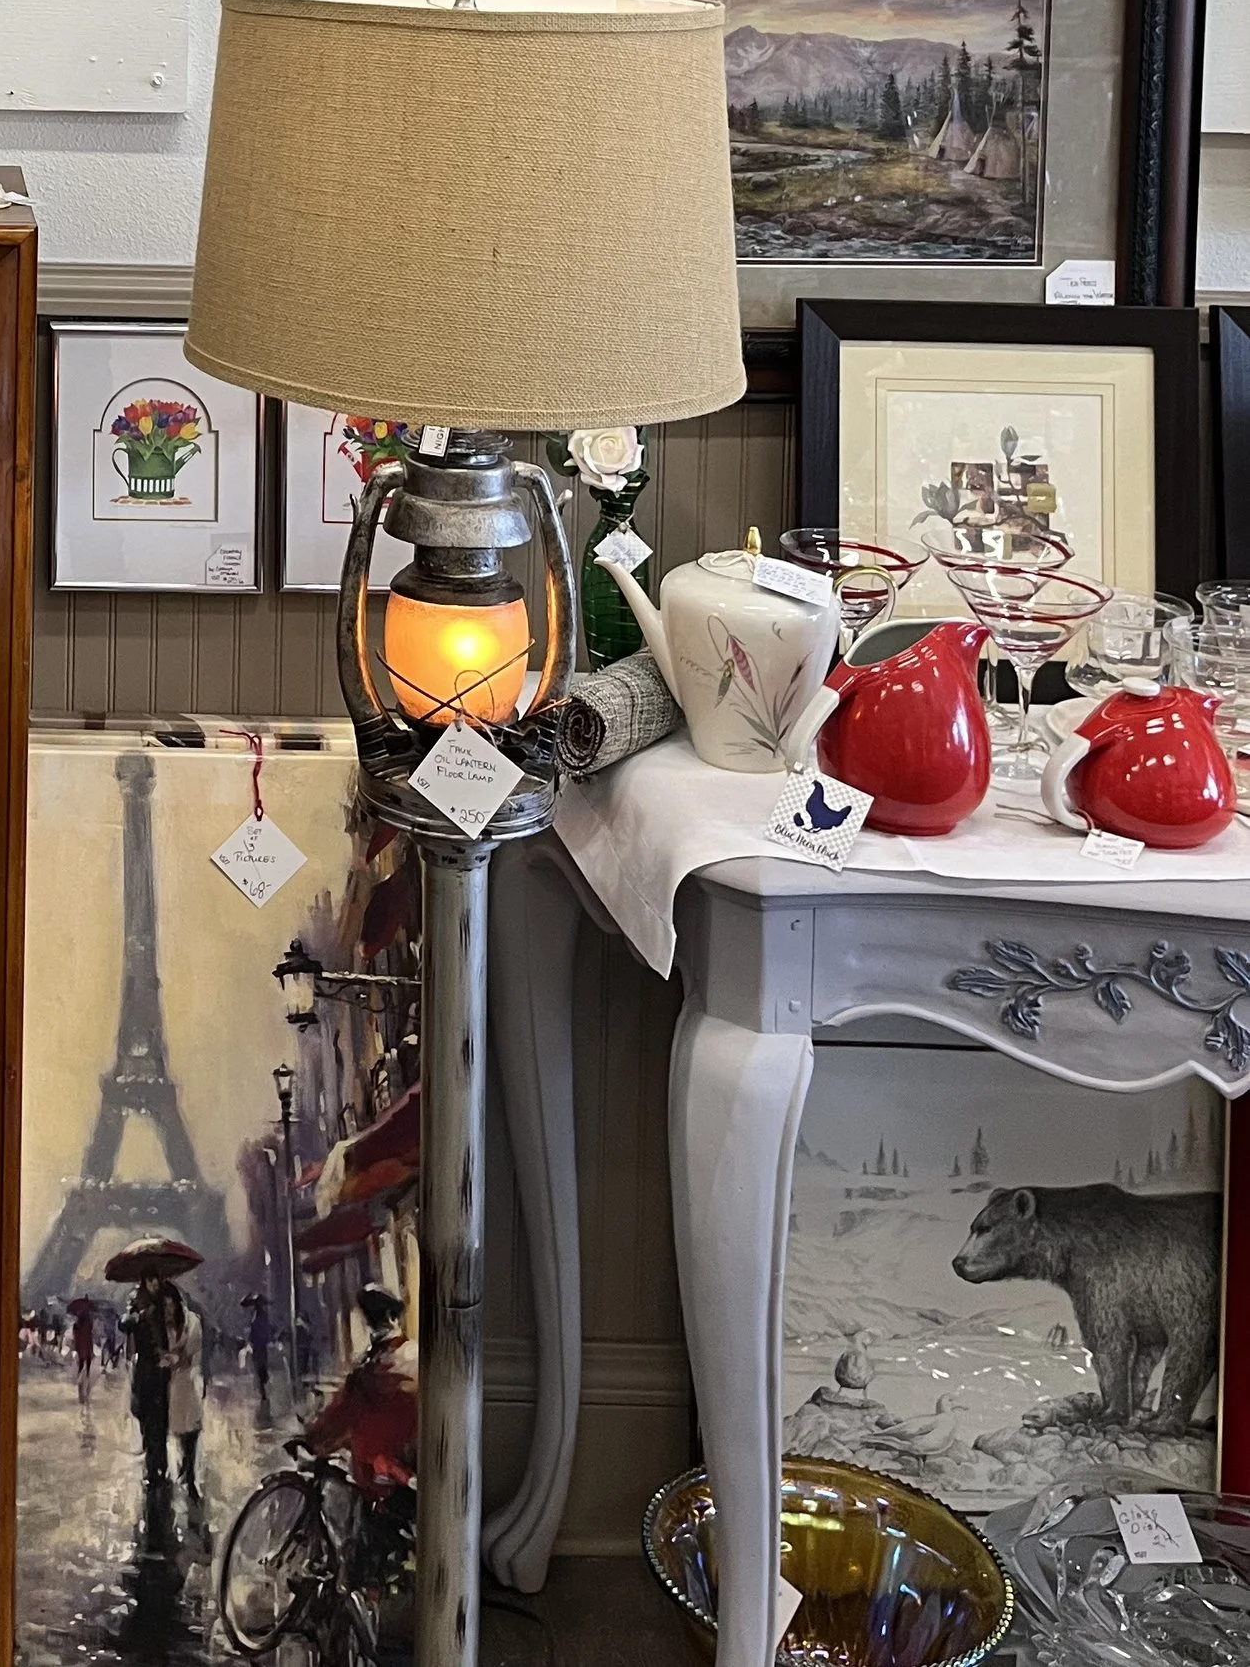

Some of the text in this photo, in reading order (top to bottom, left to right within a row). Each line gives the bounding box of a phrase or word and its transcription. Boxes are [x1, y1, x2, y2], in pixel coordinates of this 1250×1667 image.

[434, 754, 497, 773] OIL LANTERN
[774, 823, 795, 841] Blue
